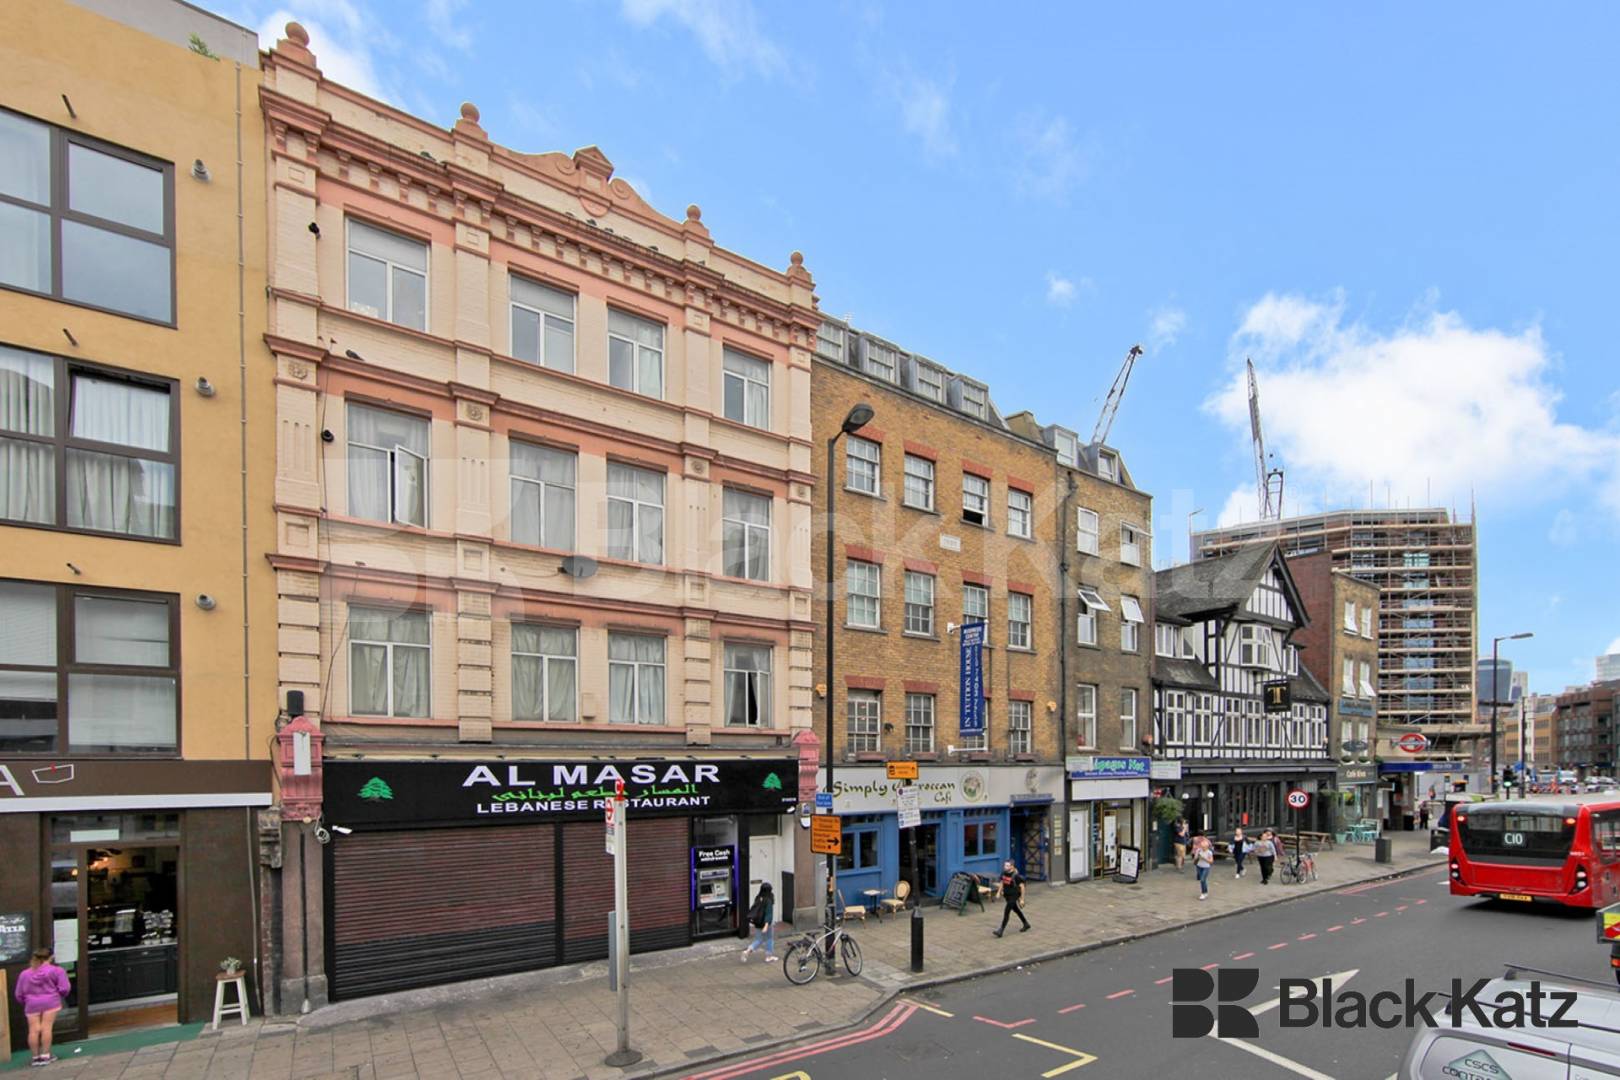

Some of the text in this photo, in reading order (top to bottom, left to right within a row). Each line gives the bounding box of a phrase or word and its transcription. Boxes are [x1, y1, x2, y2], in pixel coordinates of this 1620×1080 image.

[462, 764, 721, 787] AL MASAR
[825, 780, 888, 799] Simply
[476, 796, 711, 814] LEBANESE RSTAURANT
[1290, 793, 1308, 804] 30
[1504, 833, 1523, 844] C10
[698, 848, 731, 858] Free Cash
[1464, 1058, 1499, 1074] CSCS
